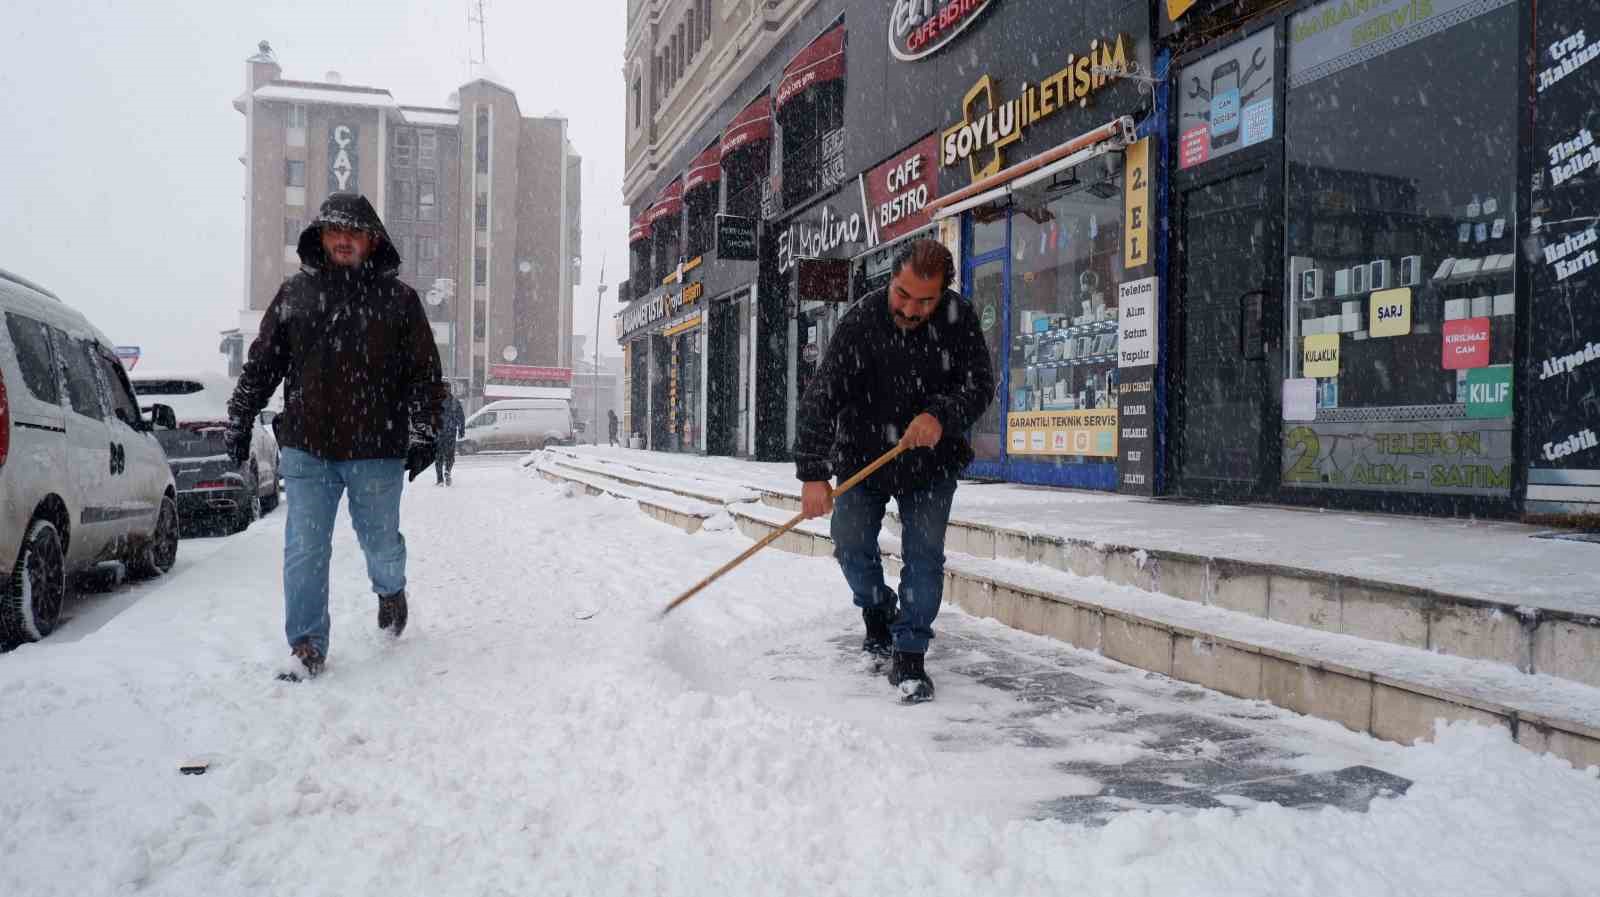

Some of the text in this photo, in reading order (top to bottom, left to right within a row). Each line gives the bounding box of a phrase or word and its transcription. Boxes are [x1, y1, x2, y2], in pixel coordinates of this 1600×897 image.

[906, 15, 938, 49] CAFE
[944, 32, 1128, 166] SOYLU İLETİŞİM
[886, 153, 922, 192] CAFE
[1131, 167, 1147, 192] 2.
[879, 183, 930, 228] BISTRO
[777, 225, 794, 275] El
[799, 205, 860, 258] Molino
[1119, 283, 1152, 297] Telefon
[1125, 305, 1145, 319] Alım
[1377, 304, 1403, 324] ŞARJ
[1122, 329, 1148, 342] Satım
[1445, 330, 1487, 345] KIRILMAZ
[1120, 348, 1150, 365] Yapılır
[1305, 348, 1338, 365] KULAKLIK
[1455, 345, 1476, 355] CAM
[1469, 382, 1509, 404] KILIF
[1009, 415, 1116, 428] GARANTİLİ TEKNİK SERVİS
[1374, 432, 1481, 455] TELEFON
[1430, 464, 1511, 489] SATIM
